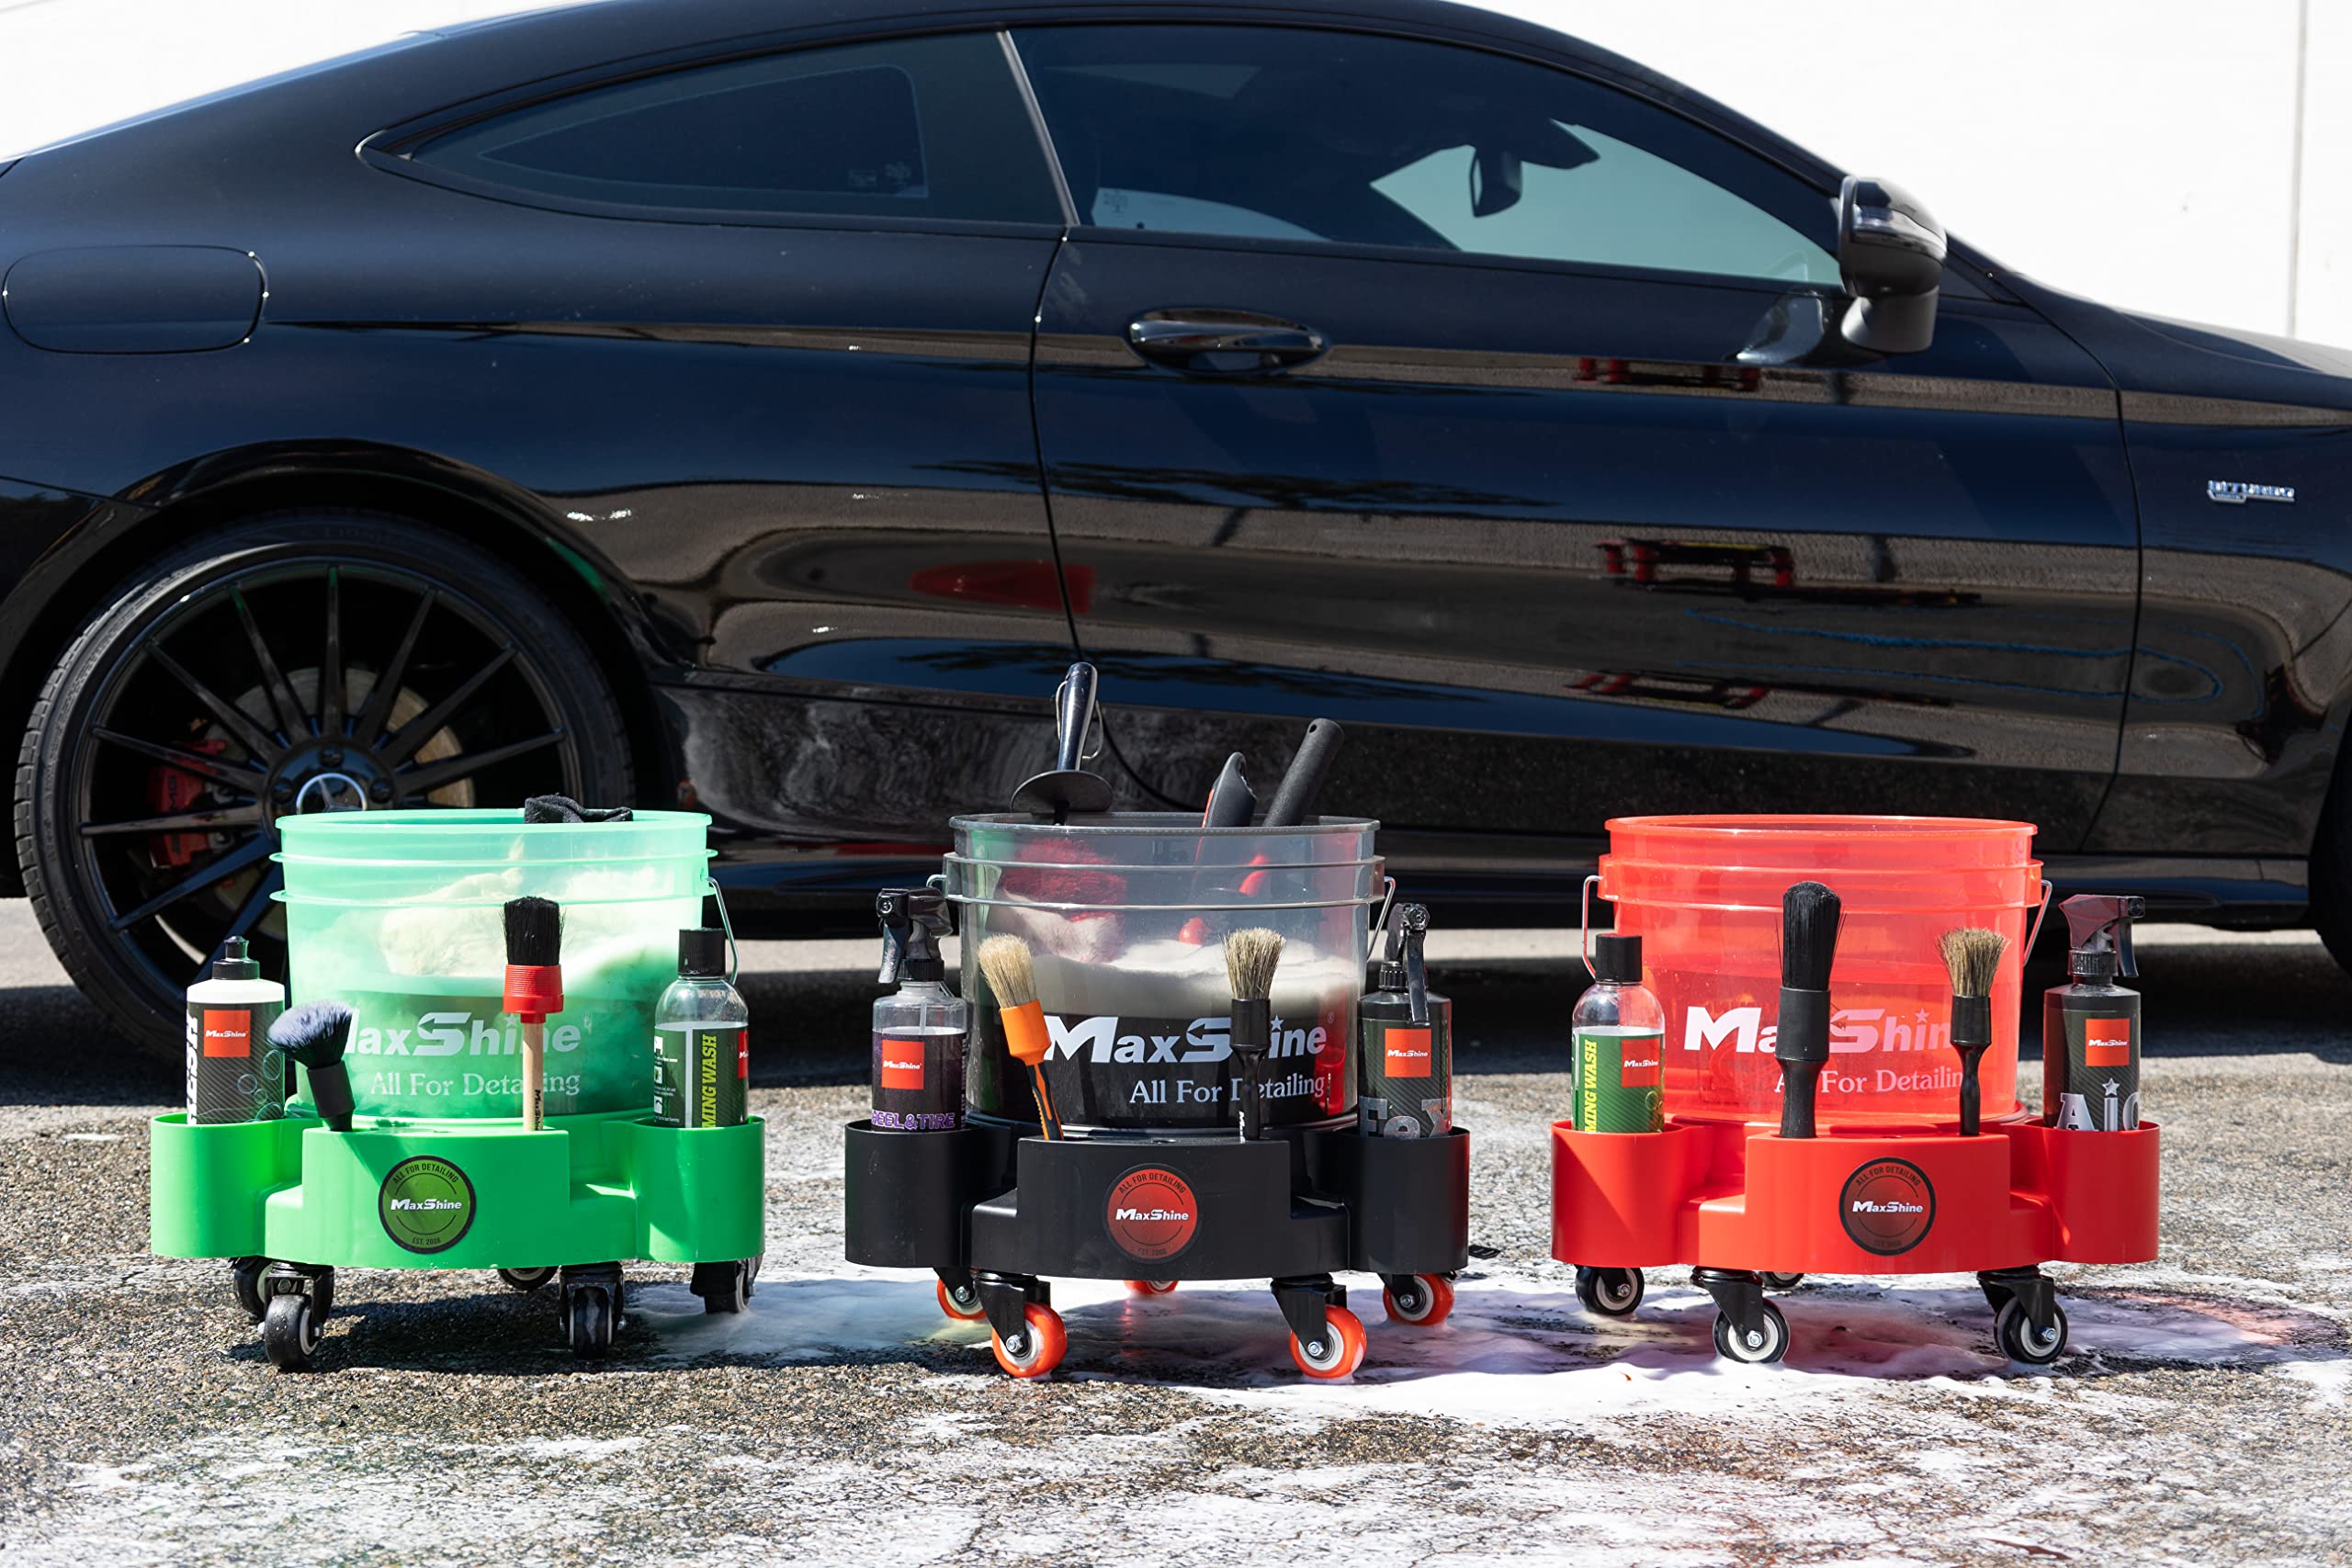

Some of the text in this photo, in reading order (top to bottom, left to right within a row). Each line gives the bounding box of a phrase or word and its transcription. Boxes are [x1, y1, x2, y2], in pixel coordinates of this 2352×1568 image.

[344, 1009, 582, 1056] axShie
[1044, 1015, 1327, 1063] MaxSine
[1684, 1006, 1951, 1054] MaShin
[702, 1033, 717, 1084] WASH
[1386, 1049, 1429, 1057] MaxShine
[1584, 1039, 1597, 1089] WASH
[883, 1059, 922, 1070] MaxShine
[370, 1072, 581, 1096] All For Detaing
[1820, 1066, 1963, 1093] For Detailin
[1129, 1079, 1166, 1103] All
[1176, 1079, 1223, 1102] For
[392, 1163, 458, 1184] ALL FOR DETAILING
[1118, 1173, 1186, 1193] ALL FOR DETAILING
[1856, 1174, 1869, 1186] ALL
[1870, 1167, 1883, 1176] FOR
[390, 1199, 462, 1210] MaxShine
[1115, 1208, 1189, 1220] MaxShine
[1852, 1201, 1923, 1213] MaxShine
